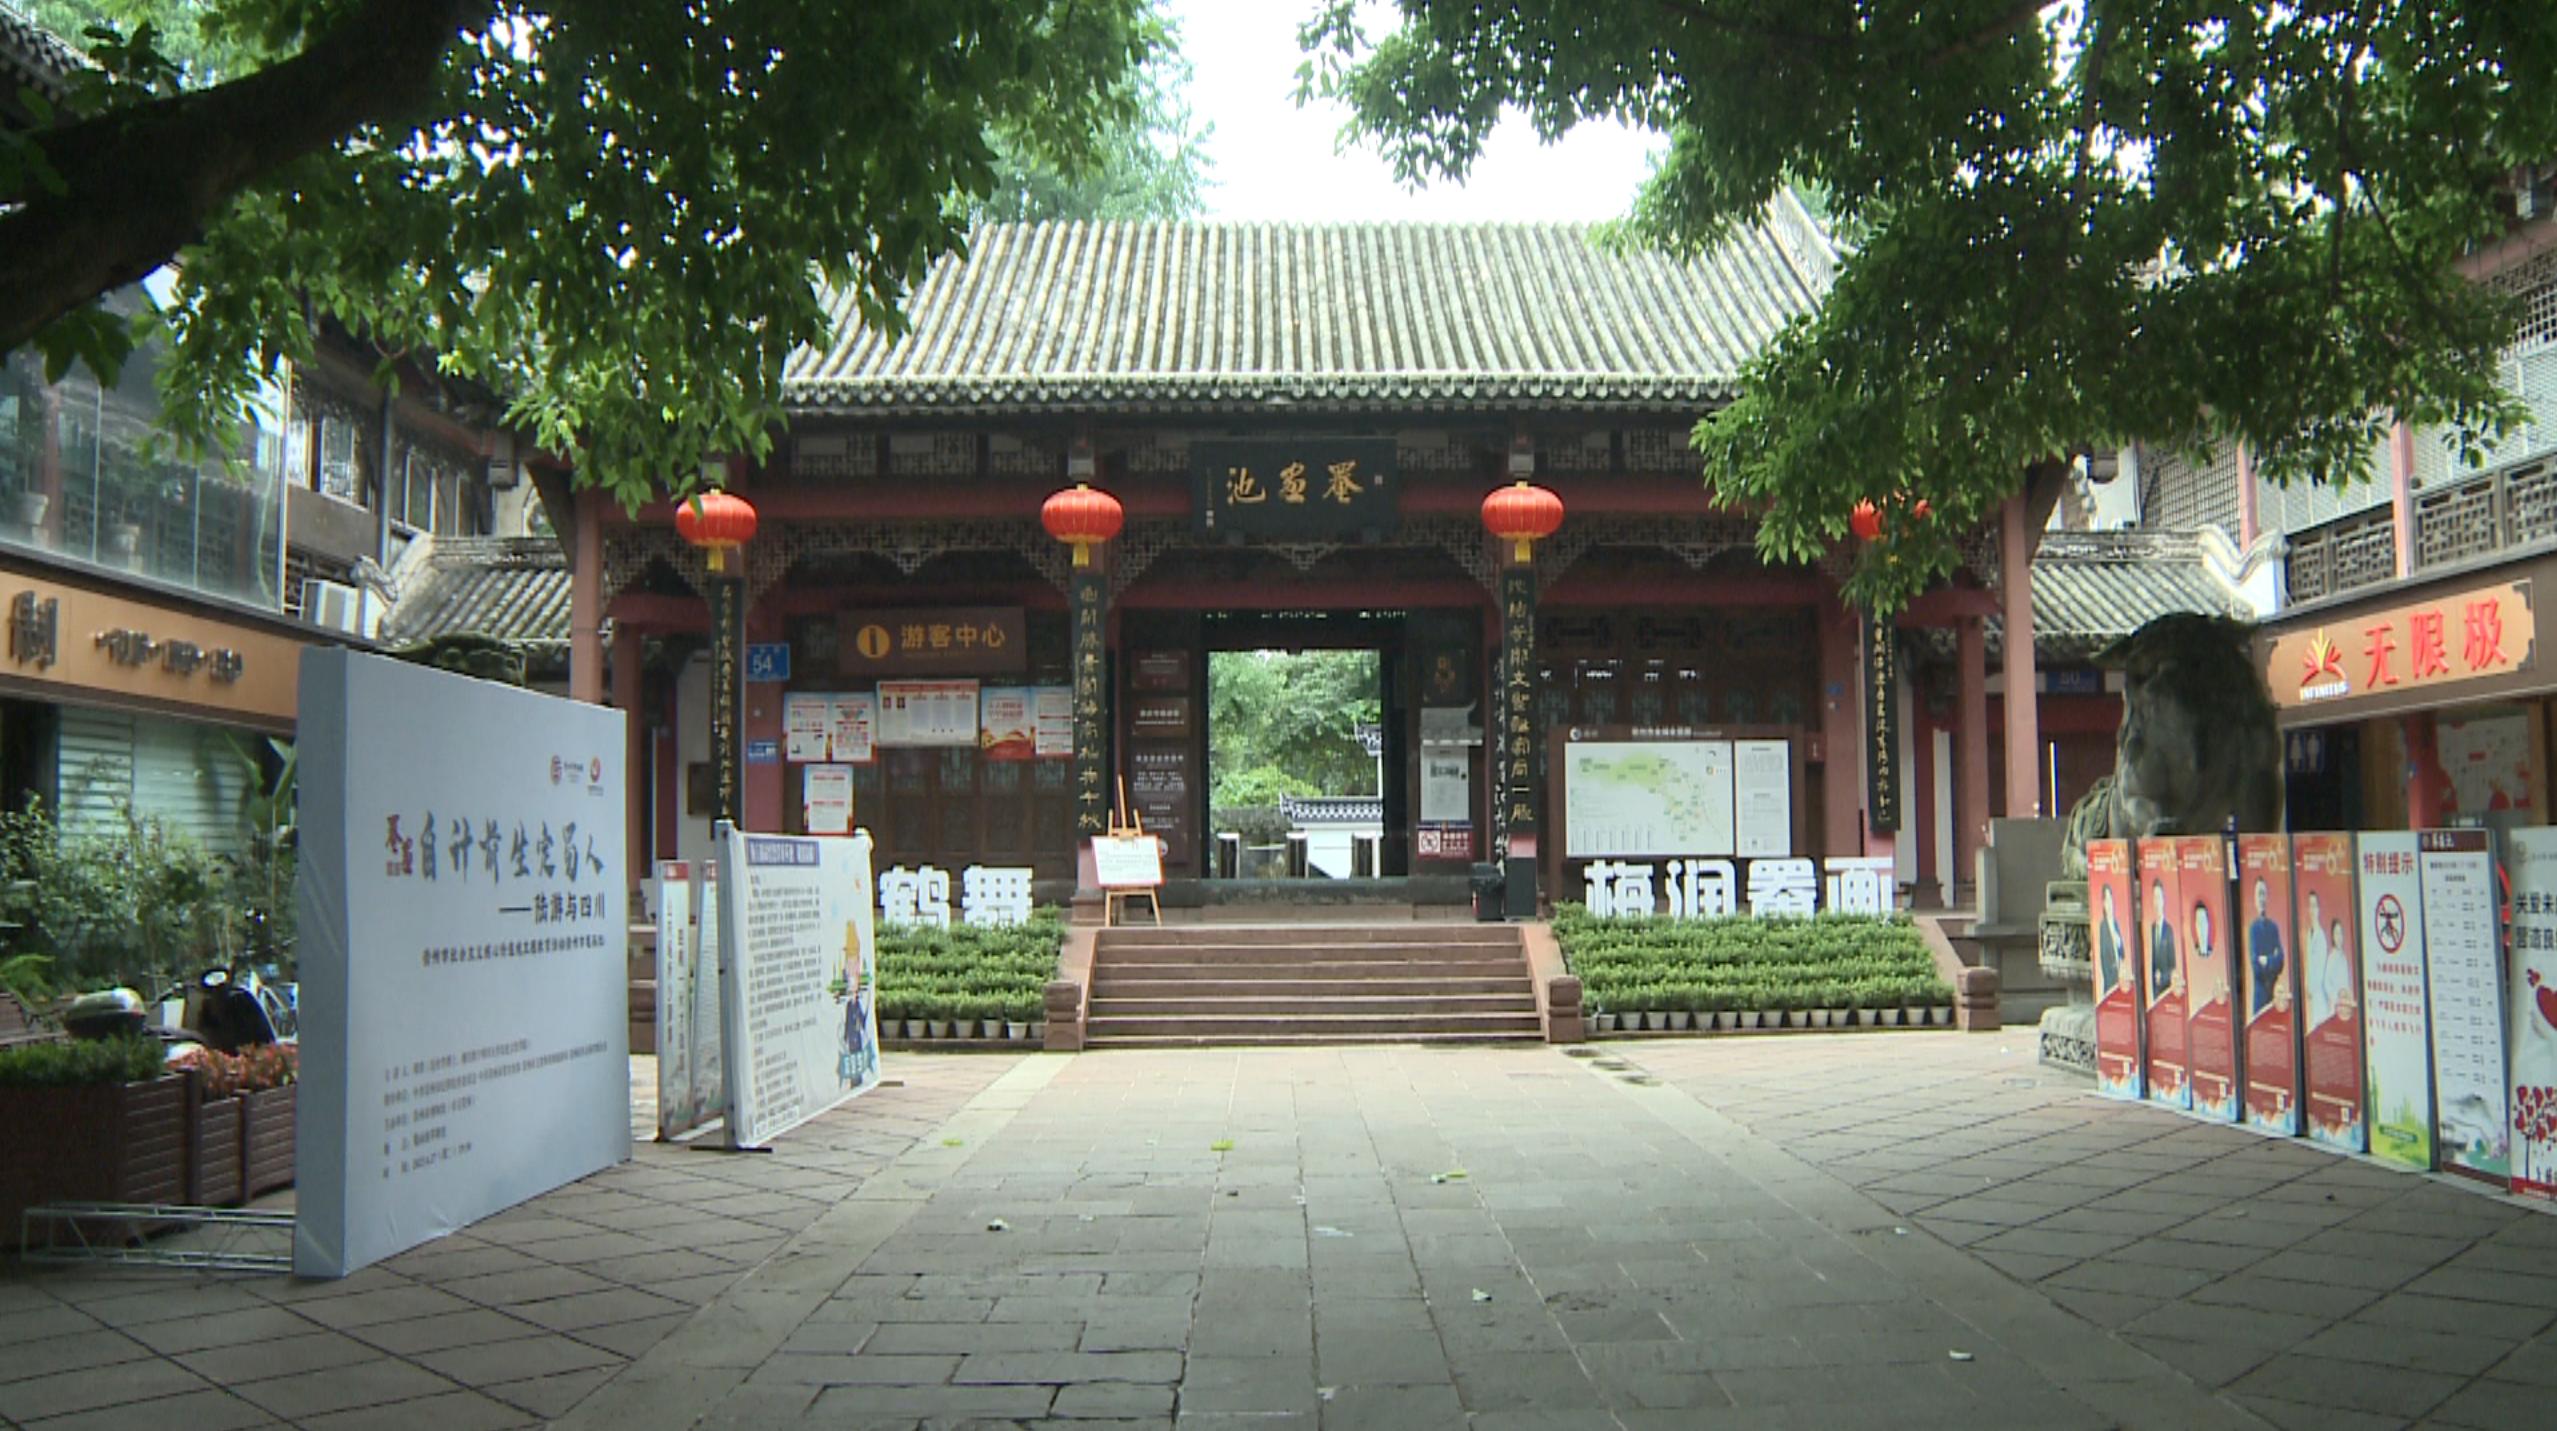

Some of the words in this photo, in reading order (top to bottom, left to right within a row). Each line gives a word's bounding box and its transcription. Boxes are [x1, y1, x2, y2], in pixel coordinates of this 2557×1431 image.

[901, 622, 1006, 648] 游客中心
[2363, 597, 2507, 690] 无限极
[752, 654, 773, 674] 54
[2363, 851, 2414, 877] 特别提示
[1583, 858, 1894, 922] 梅润罨画
